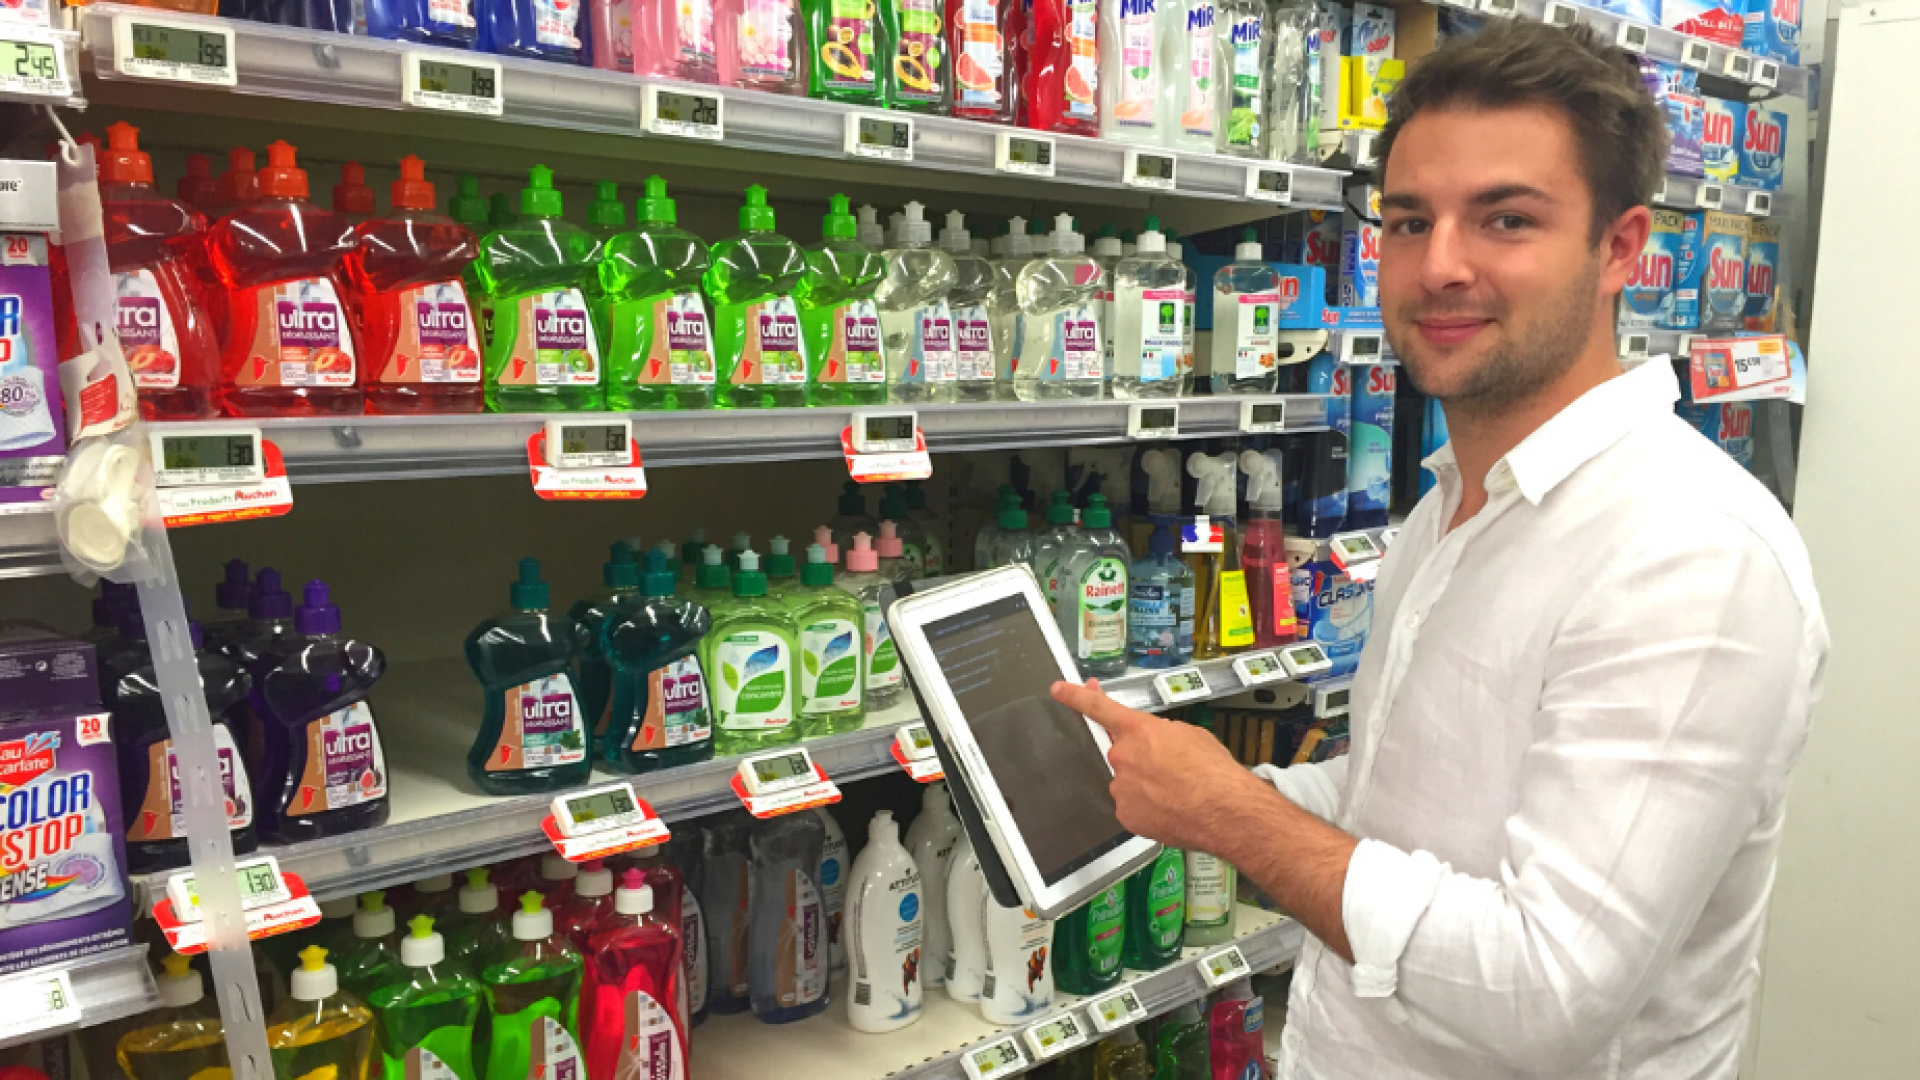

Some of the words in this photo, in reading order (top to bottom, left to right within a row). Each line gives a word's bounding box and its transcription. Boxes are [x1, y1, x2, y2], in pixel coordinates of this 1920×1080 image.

[1701, 112, 1732, 145] un
[1745, 109, 1780, 154] Sun
[1709, 247, 1743, 289] Sun
[280, 308, 336, 329] ultra
[420, 311, 466, 329] ultra
[537, 316, 585, 334] ultra
[525, 701, 570, 720] ultra
[79, 717, 100, 734] 20
[326, 731, 371, 755] ultra
[5, 814, 82, 867] STOP
